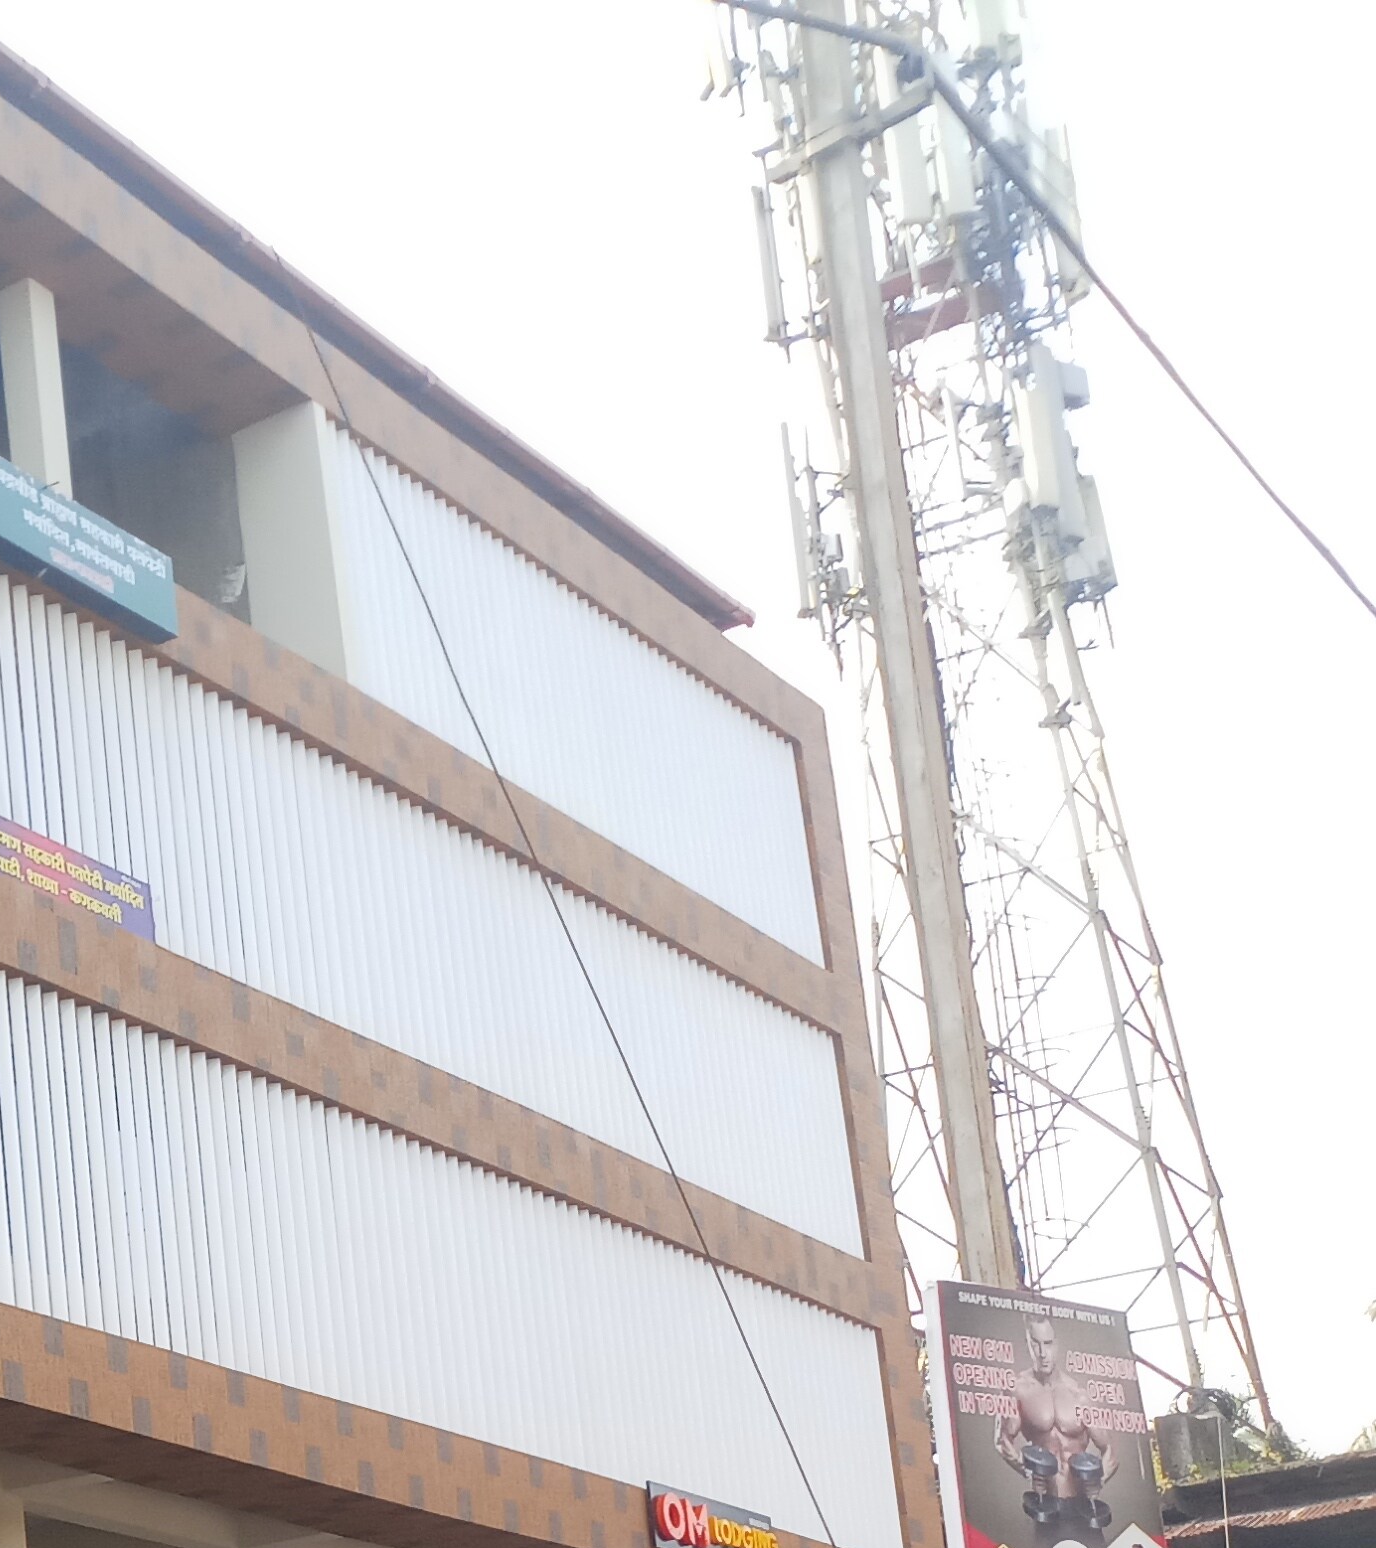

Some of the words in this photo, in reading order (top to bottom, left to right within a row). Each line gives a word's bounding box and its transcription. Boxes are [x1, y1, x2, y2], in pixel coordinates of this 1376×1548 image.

[958, 1291, 988, 1306] SHAPE
[988, 1296, 1013, 1310] YOUR
[1014, 1300, 1051, 1317] PERFECT
[1051, 1305, 1075, 1320] BODY
[1075, 1310, 1099, 1324] WITH
[949, 1334, 983, 1360] NEW
[953, 1362, 1017, 1392] OPENING
[1066, 1350, 1138, 1382] ADMISSION
[975, 1392, 1020, 1418] TOWN
[1087, 1379, 1126, 1406] OPEN
